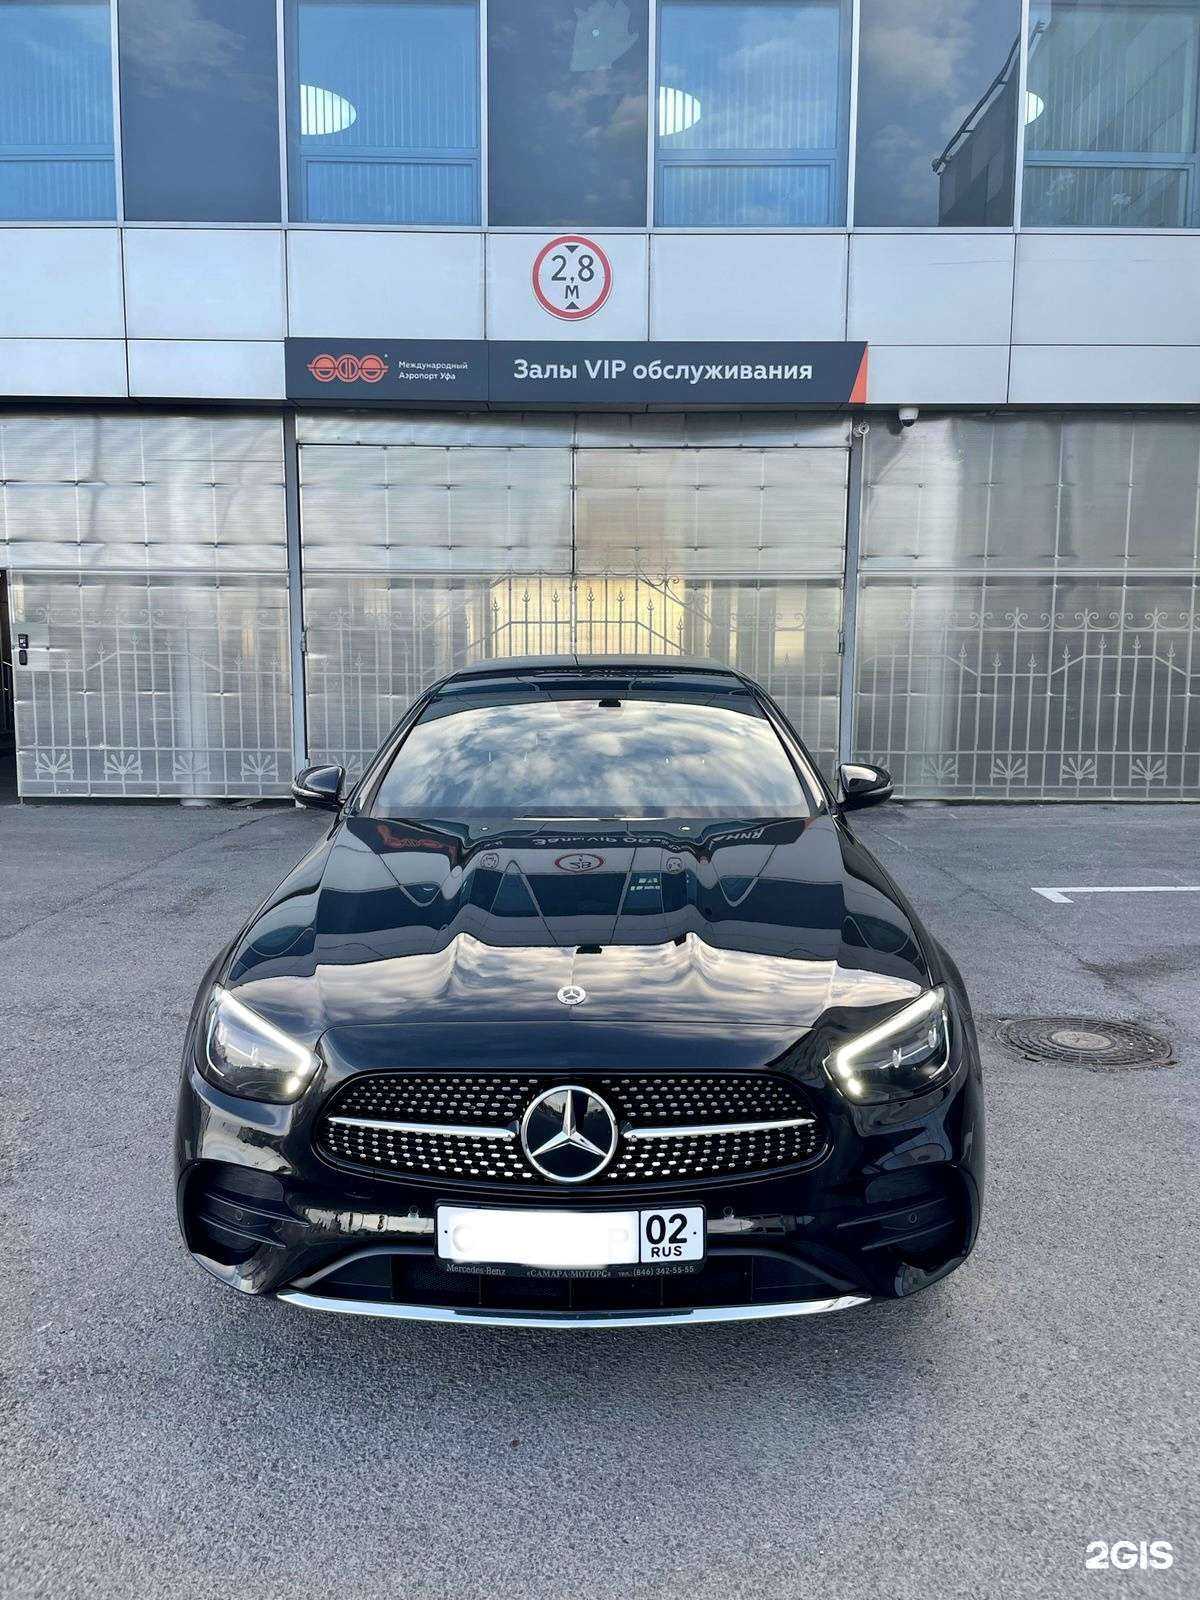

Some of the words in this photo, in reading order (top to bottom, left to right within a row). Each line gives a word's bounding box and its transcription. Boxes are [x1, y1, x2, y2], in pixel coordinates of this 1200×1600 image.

[551, 254, 595, 283] 2,8
[398, 360, 469, 370] Международный
[398, 371, 438, 382] Аэропорт
[439, 372, 457, 381] Уфа
[513, 359, 577, 379] Залы
[584, 360, 627, 379] VIP
[632, 359, 813, 385] обслуживания
[645, 1213, 688, 1245] 02
[651, 1245, 683, 1258] RUS
[446, 1263, 507, 1276] Mercedes-Benz
